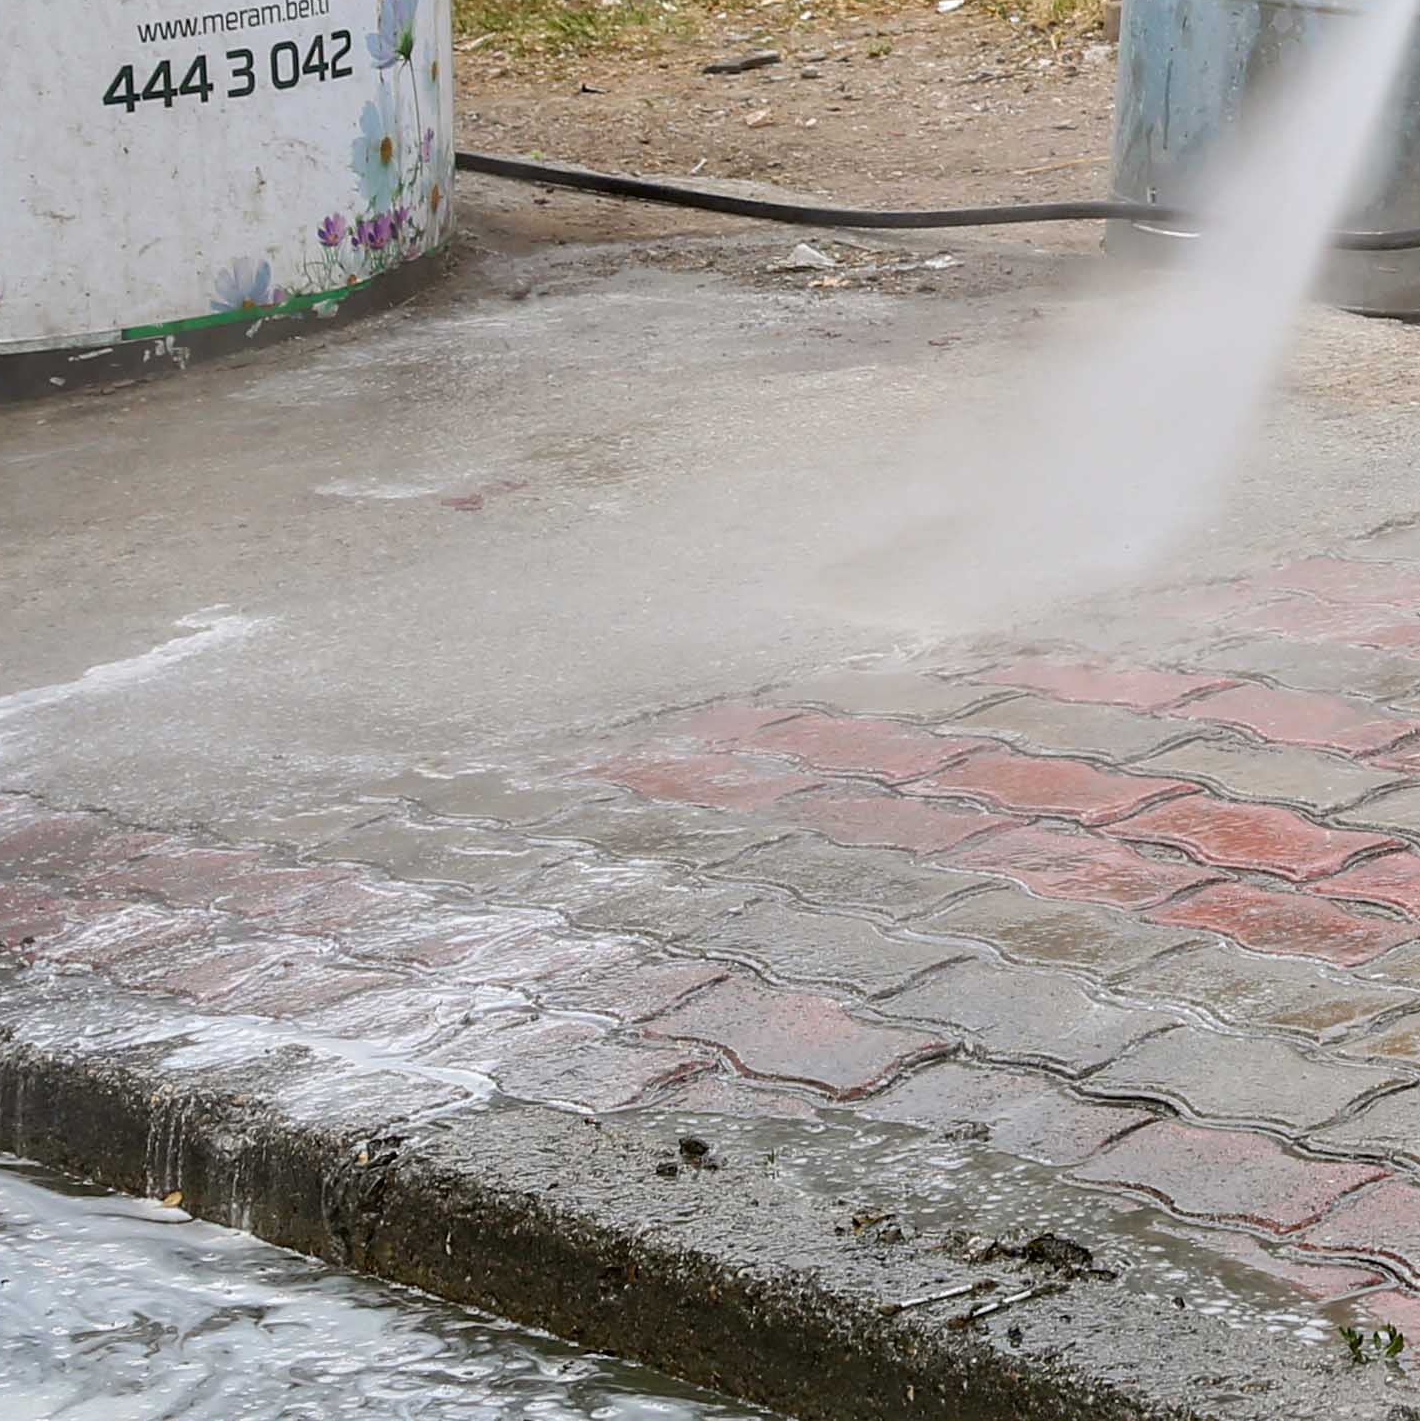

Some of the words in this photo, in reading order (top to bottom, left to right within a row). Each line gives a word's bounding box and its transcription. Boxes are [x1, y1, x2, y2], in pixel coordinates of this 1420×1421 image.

[103, 54, 213, 113] 444
[226, 48, 255, 98] 3
[270, 29, 352, 90] 042
